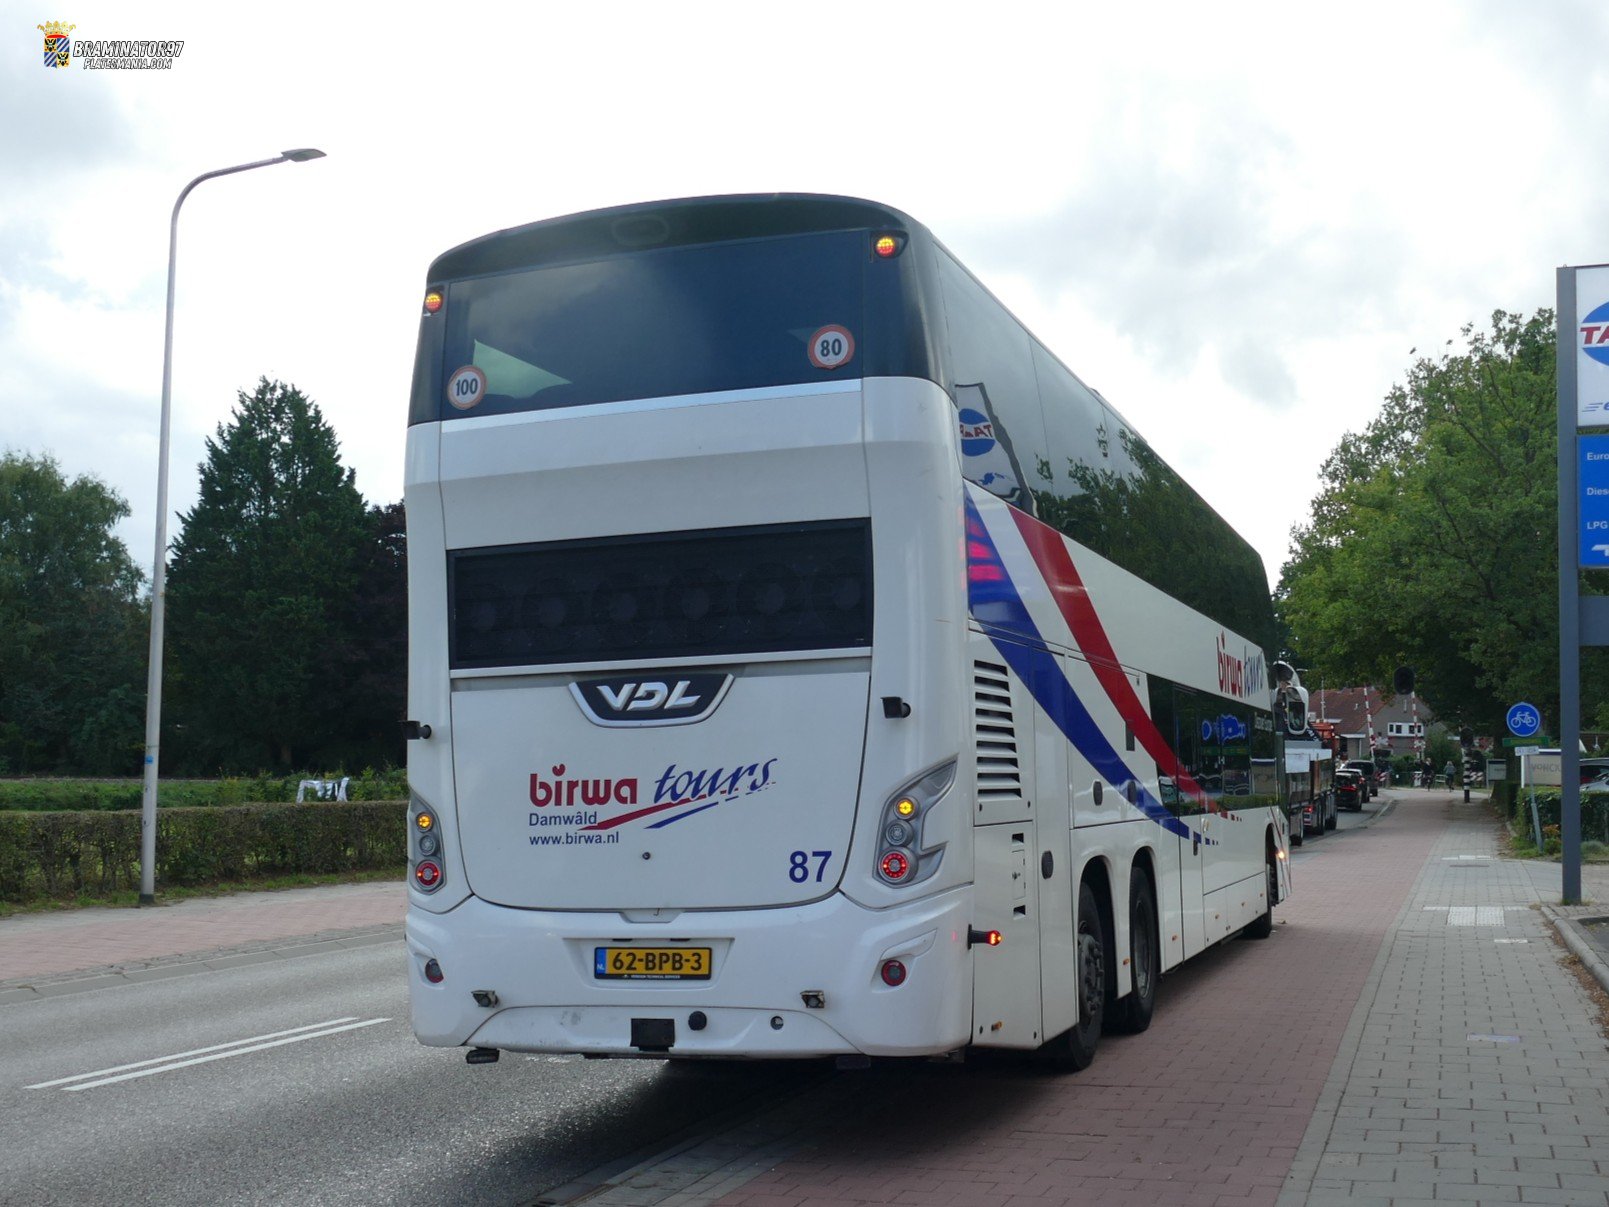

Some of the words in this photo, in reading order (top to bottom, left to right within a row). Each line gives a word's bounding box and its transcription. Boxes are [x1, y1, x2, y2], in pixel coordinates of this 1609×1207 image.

[821, 338, 842, 357] 80
[456, 378, 478, 396] 100
[1586, 487, 1609, 496] Dies
[1586, 520, 1608, 530] LPG
[1216, 630, 1243, 698] birwa
[596, 680, 701, 711] VDL
[530, 763, 638, 807] birwa
[653, 758, 778, 803] tours
[529, 811, 598, 826] Damwâld
[529, 831, 619, 845] www.birwa.nl
[789, 850, 832, 883] 87
[612, 952, 702, 971] 62-BPB-3
